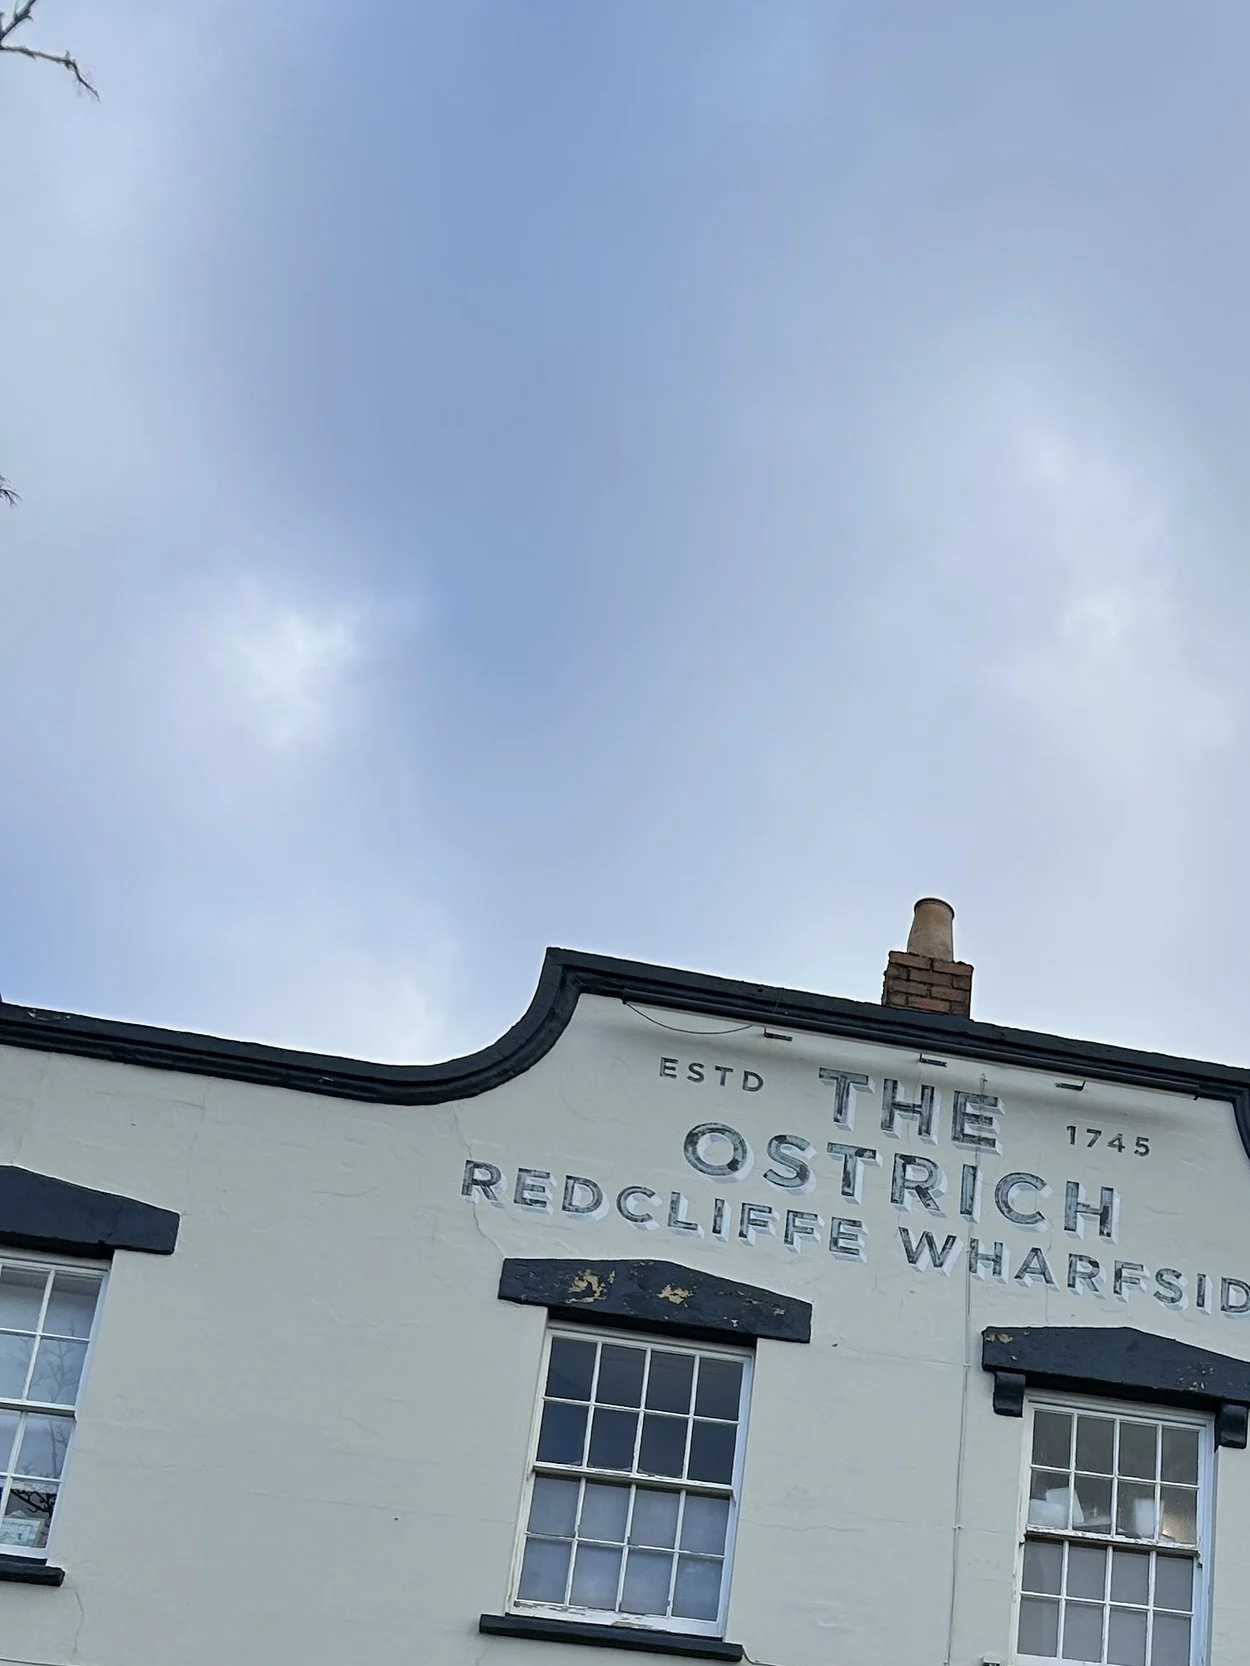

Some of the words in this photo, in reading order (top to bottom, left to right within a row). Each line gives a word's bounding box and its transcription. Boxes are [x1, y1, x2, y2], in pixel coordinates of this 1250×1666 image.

[659, 1057, 765, 1093] ESTD
[817, 1065, 1006, 1153] THE
[682, 1121, 1123, 1245] OSTRICH
[1065, 1124, 1152, 1158] 1745
[460, 1158, 868, 1265] REDCLIFFE
